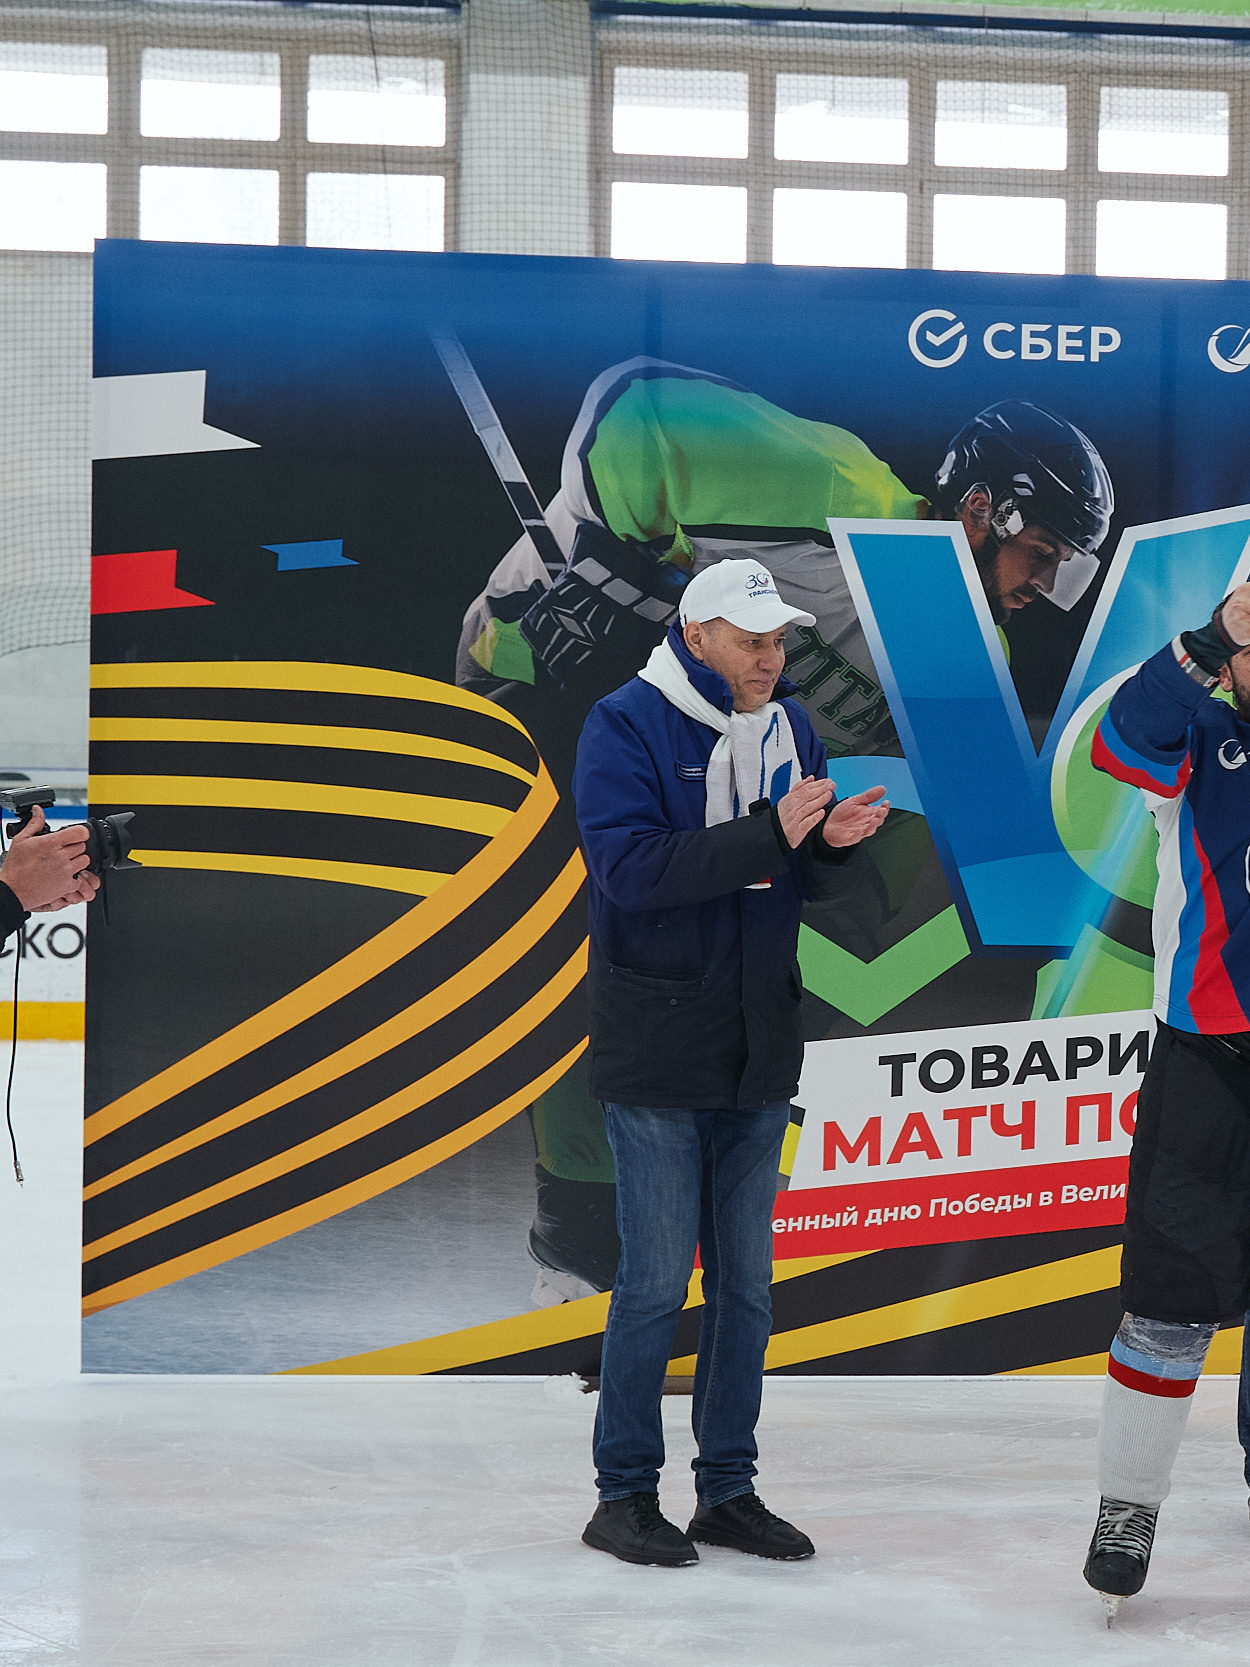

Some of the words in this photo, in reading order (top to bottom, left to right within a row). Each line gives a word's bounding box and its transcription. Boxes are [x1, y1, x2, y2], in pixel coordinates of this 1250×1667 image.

[983, 322, 1122, 362] СБЕР
[0, 922, 85, 959] КО
[878, 1030, 1150, 1098] ТОВАРИ
[822, 1100, 1037, 1172] МАТЧ
[771, 1206, 859, 1234] енный
[864, 1204, 922, 1227] дню
[929, 1192, 1033, 1218] Победы
[1039, 1191, 1053, 1206] в
[1060, 1183, 1127, 1204] Вели
